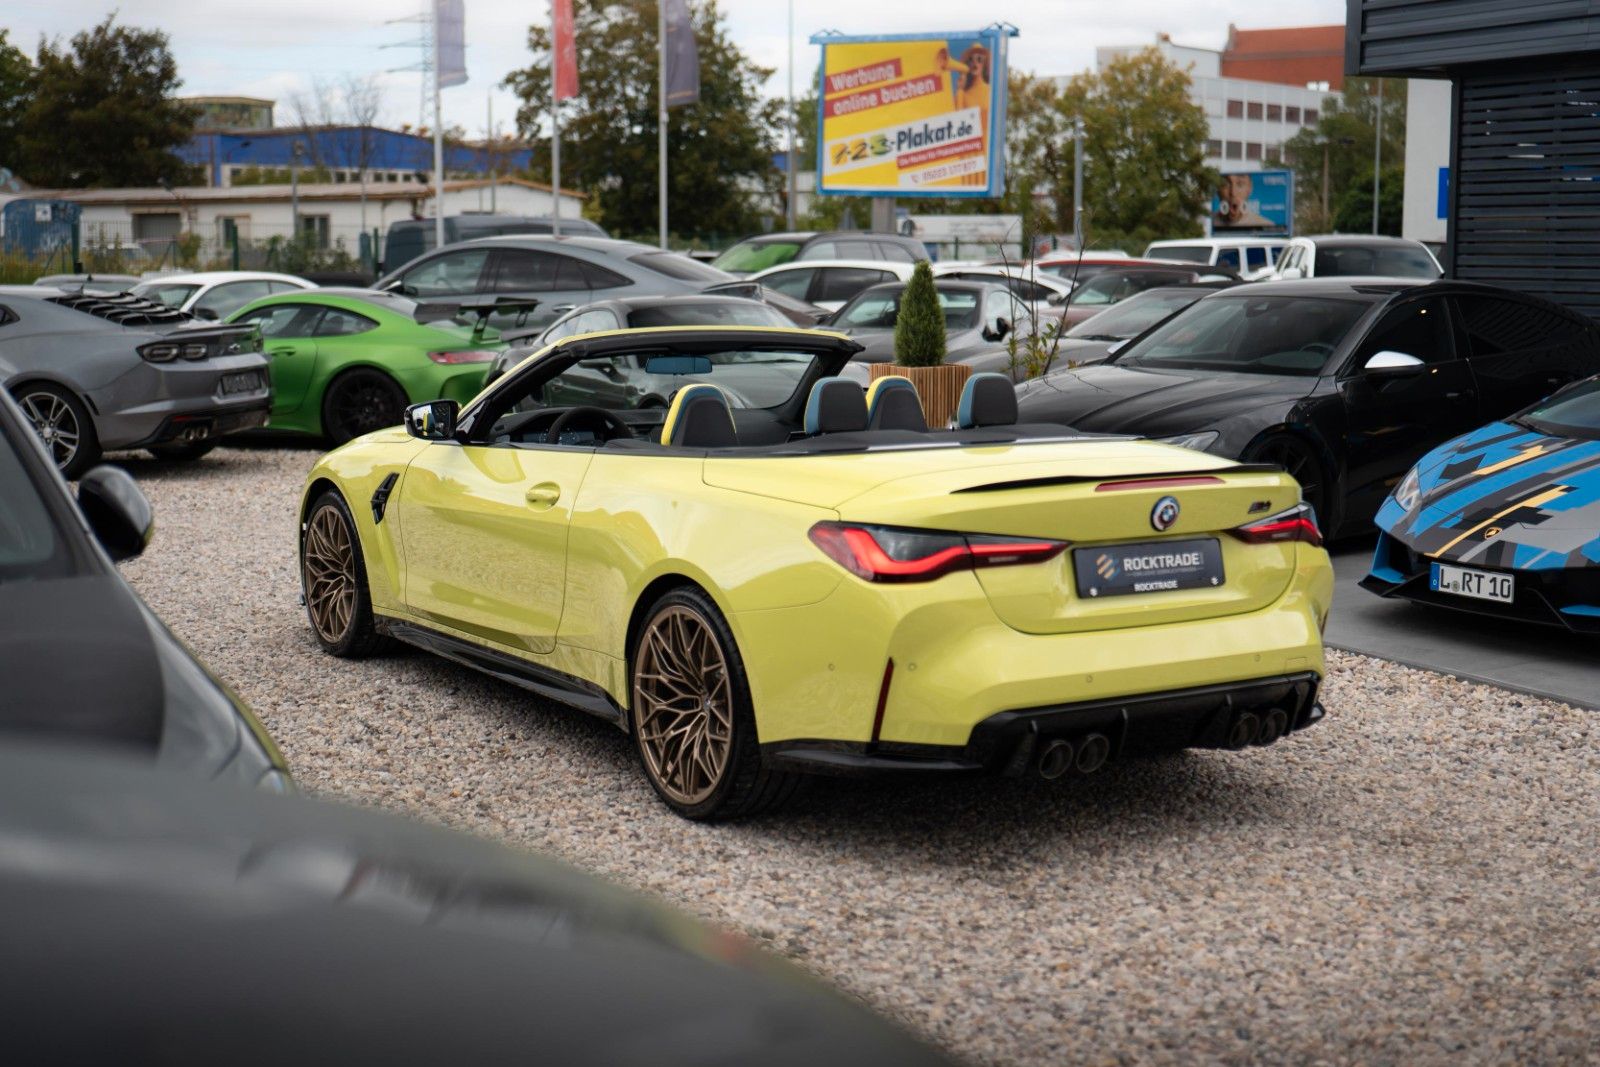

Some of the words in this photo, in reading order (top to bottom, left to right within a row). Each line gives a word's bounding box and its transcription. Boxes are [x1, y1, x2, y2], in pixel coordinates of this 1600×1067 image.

[830, 64, 895, 90] Werbung
[833, 91, 878, 115] online
[880, 78, 936, 104] buchen
[1123, 552, 1200, 571] ROCKTRADE
[1134, 580, 1178, 592] ROCKTRADE
[1440, 569, 1450, 588] L
[1489, 577, 1510, 598] 10
